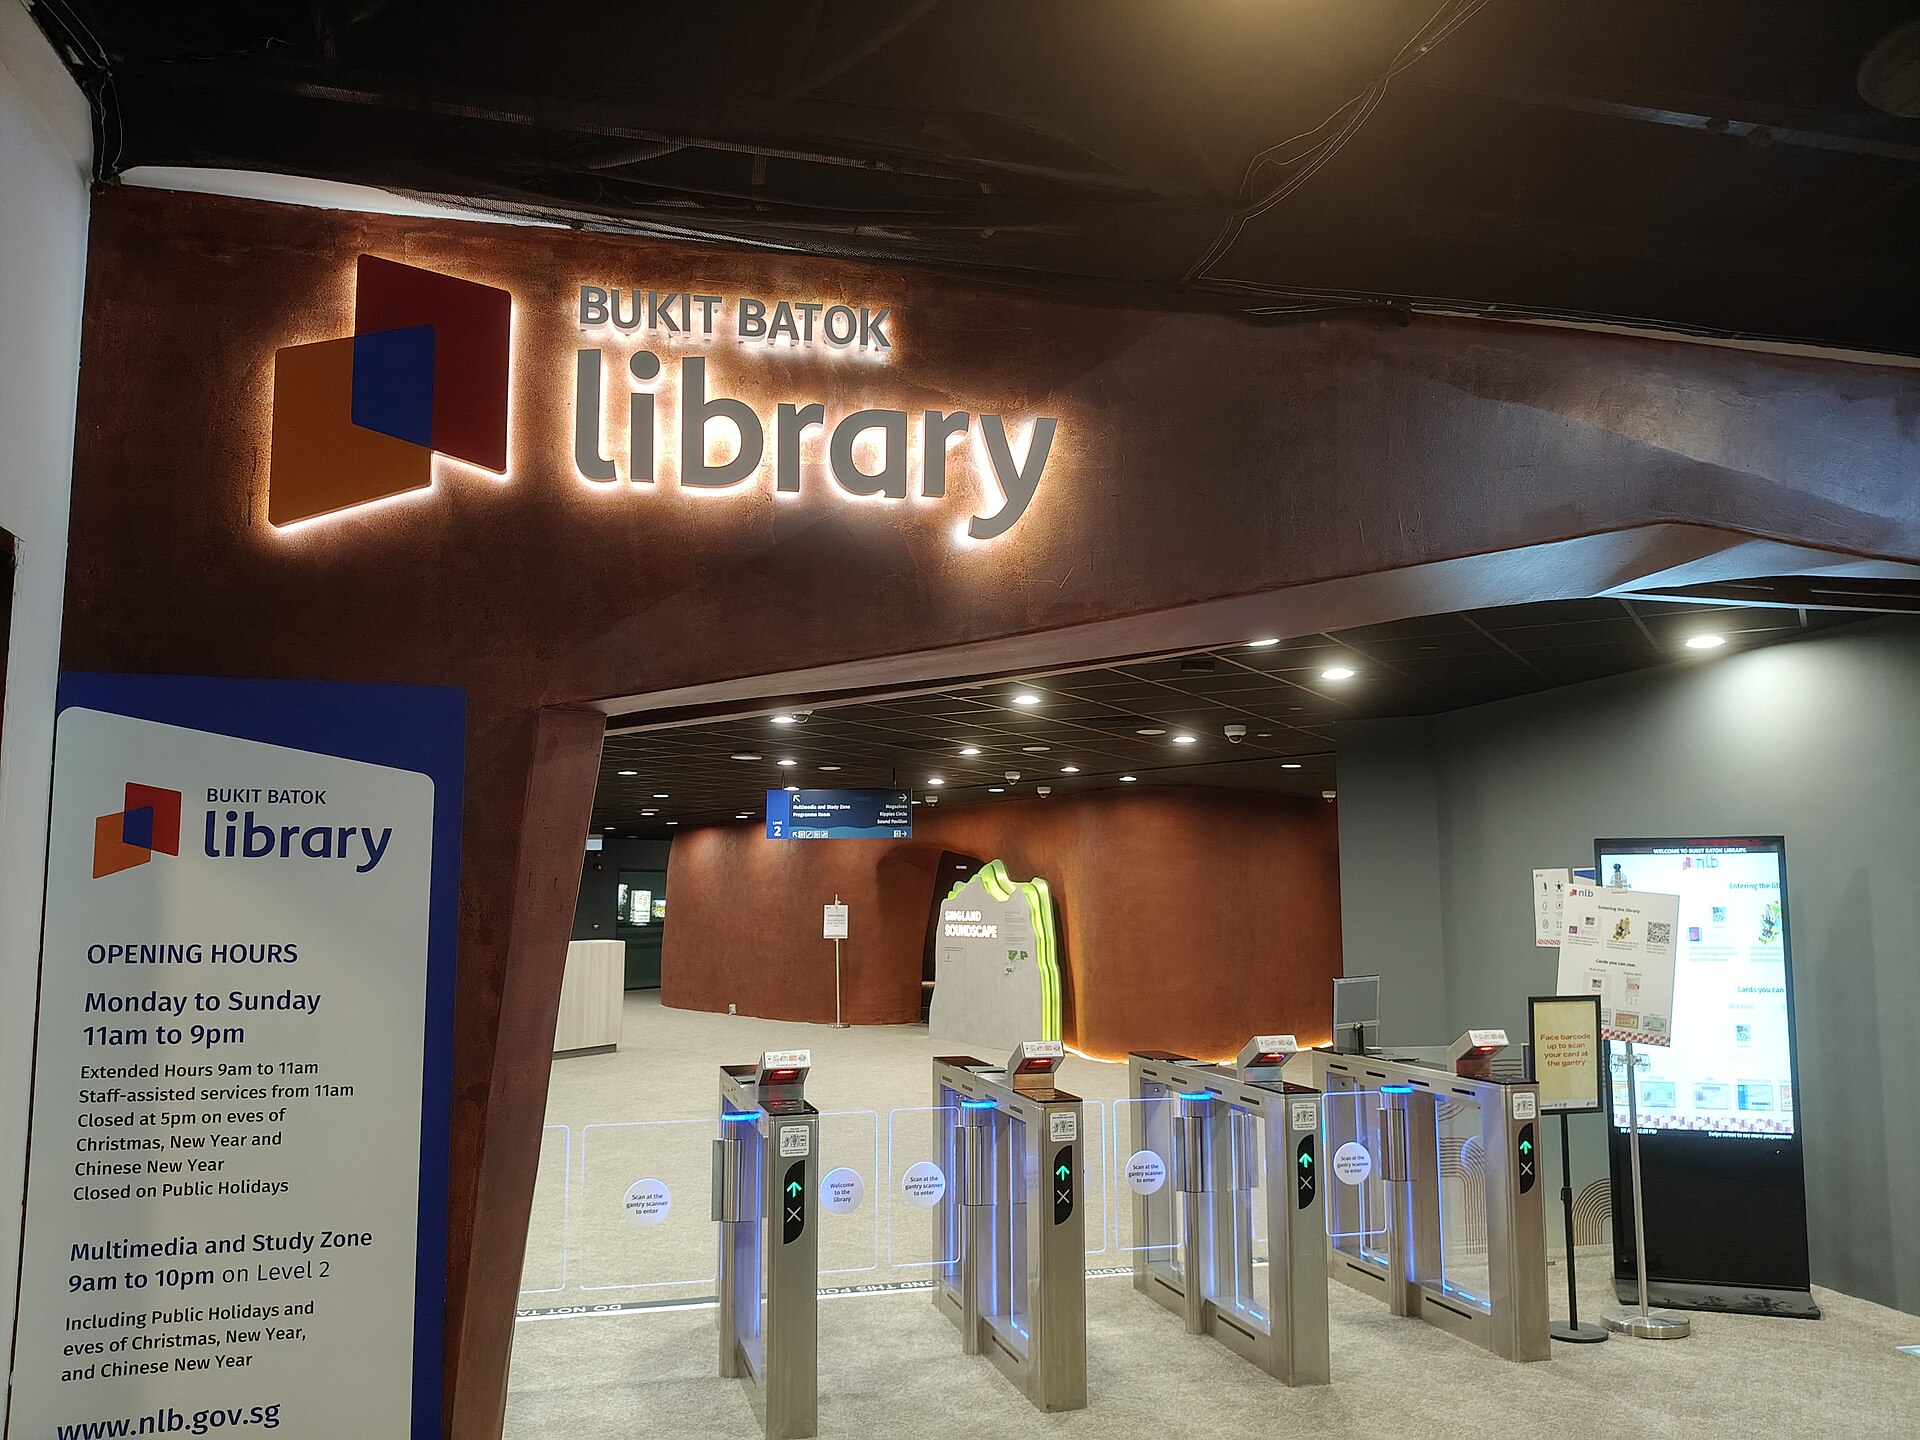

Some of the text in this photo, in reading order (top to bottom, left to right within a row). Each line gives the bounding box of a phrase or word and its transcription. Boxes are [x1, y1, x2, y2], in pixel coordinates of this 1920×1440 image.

[579, 285, 892, 350] BUKIT BATOK
[575, 349, 1057, 540] library
[207, 788, 326, 804] BUKIT BATOK
[773, 825, 782, 837] 2
[205, 811, 392, 873] library
[1696, 855, 1719, 868] nlb
[1578, 888, 1594, 897] nlb
[1729, 882, 1758, 890] Entering
[944, 924, 998, 938] SOUNDSCAPE
[88, 944, 297, 964] OPENING HOURS
[85, 990, 321, 1017] Monday to Sunday
[84, 1025, 244, 1049] 11am to 9pm
[81, 1062, 318, 1079] Extended Hours 9am to 11am
[1561, 1060, 1586, 1068] gantry
[79, 1085, 353, 1103] Staff-assisted services from 11am
[78, 1108, 286, 1128] Closed at 5pm on eves of
[77, 1131, 281, 1152] Christmas, New Year and
[75, 1159, 224, 1176] Chinese New Year
[74, 1179, 288, 1200] Closed on Public Holidays
[71, 1231, 372, 1261] Multimedia and Study Zone
[69, 1261, 329, 1293] 9am to 10pm on Level 2
[66, 1301, 314, 1331] Including Public Holidays and
[546, 1306, 586, 1315] NOT
[64, 1328, 305, 1356] eves of Christmas, New Year,
[61, 1355, 253, 1381] and Chinese New Year
[57, 1404, 280, 1440] www.nlb.gov.sg
